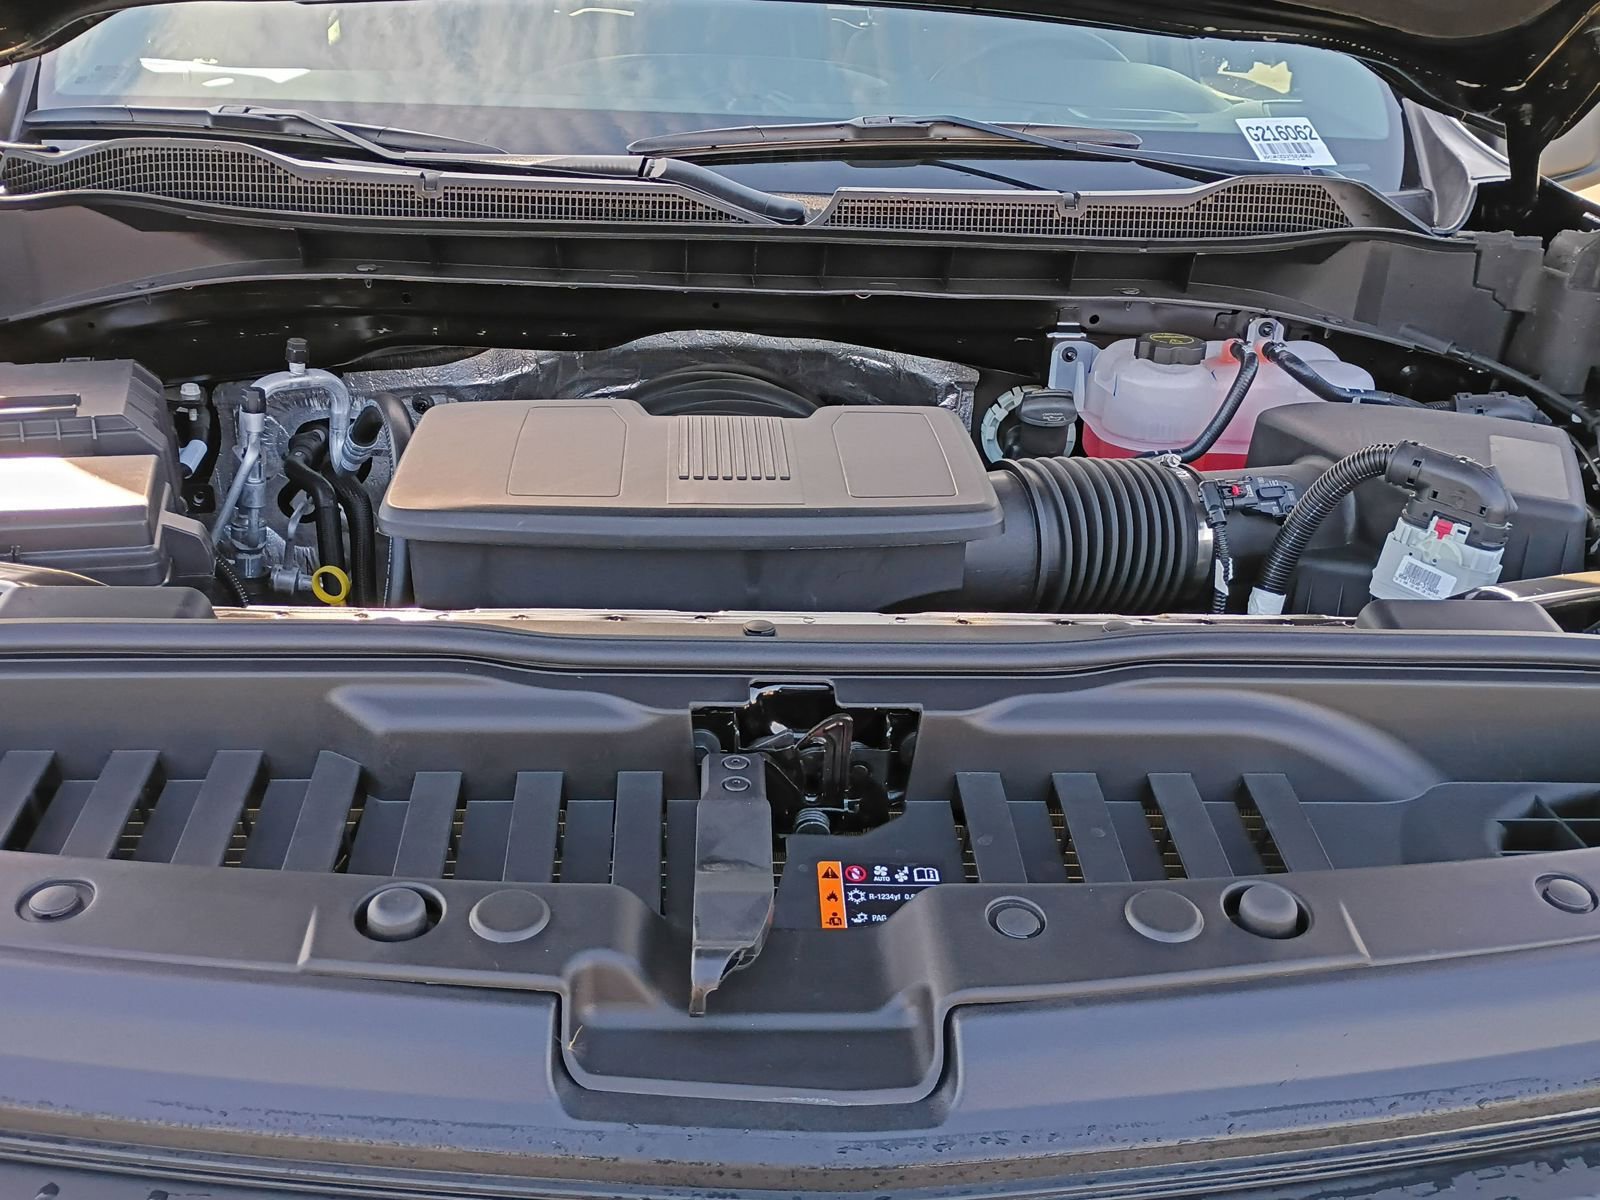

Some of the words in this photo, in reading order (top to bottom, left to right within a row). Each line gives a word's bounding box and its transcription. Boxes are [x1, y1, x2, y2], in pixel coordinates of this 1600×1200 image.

[1245, 125, 1319, 142] G216062
[868, 893, 901, 901] R-1234yf
[872, 914, 887, 922] PAG
